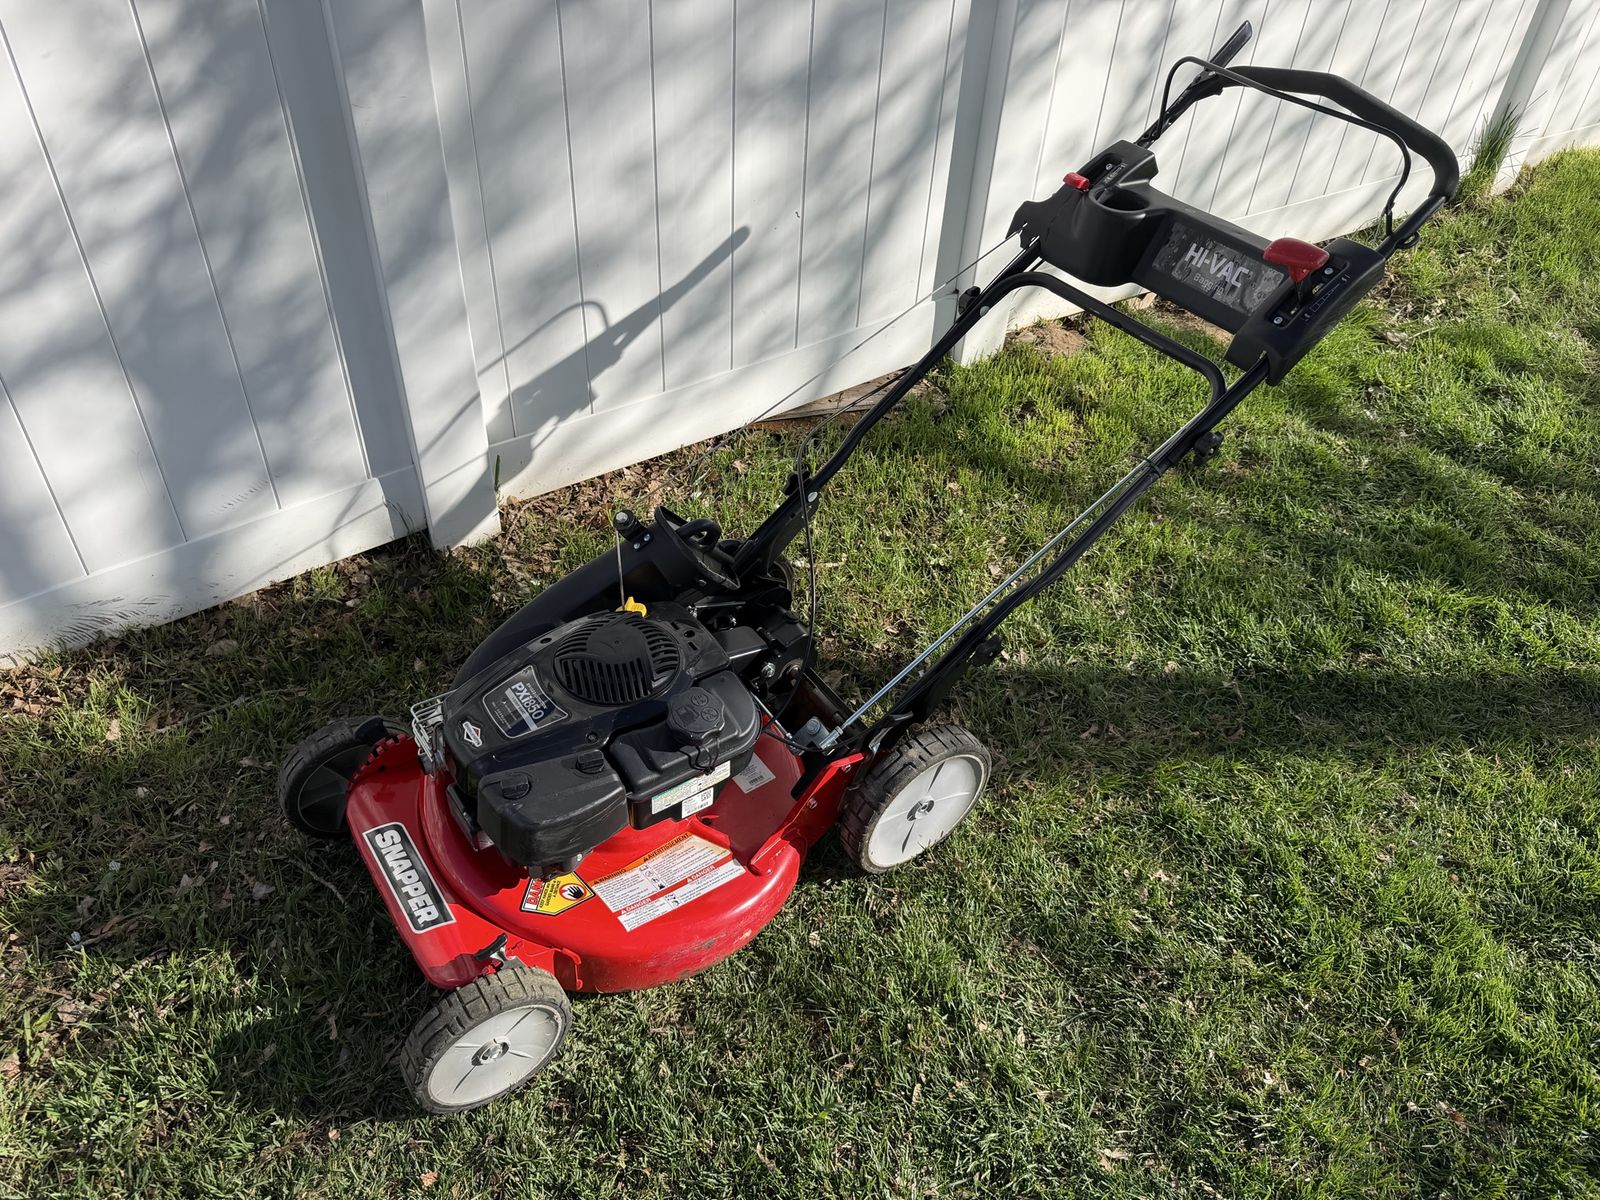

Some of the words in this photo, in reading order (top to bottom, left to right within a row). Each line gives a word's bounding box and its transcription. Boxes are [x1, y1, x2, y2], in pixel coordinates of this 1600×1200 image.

[1185, 243, 1249, 288] HI-VAC
[511, 682, 544, 719] PXi850
[648, 832, 690, 860] AVERTISSEMENT
[375, 829, 439, 925] SNAPPER
[692, 865, 715, 881] DANGER
[626, 898, 651, 913] DANGER
